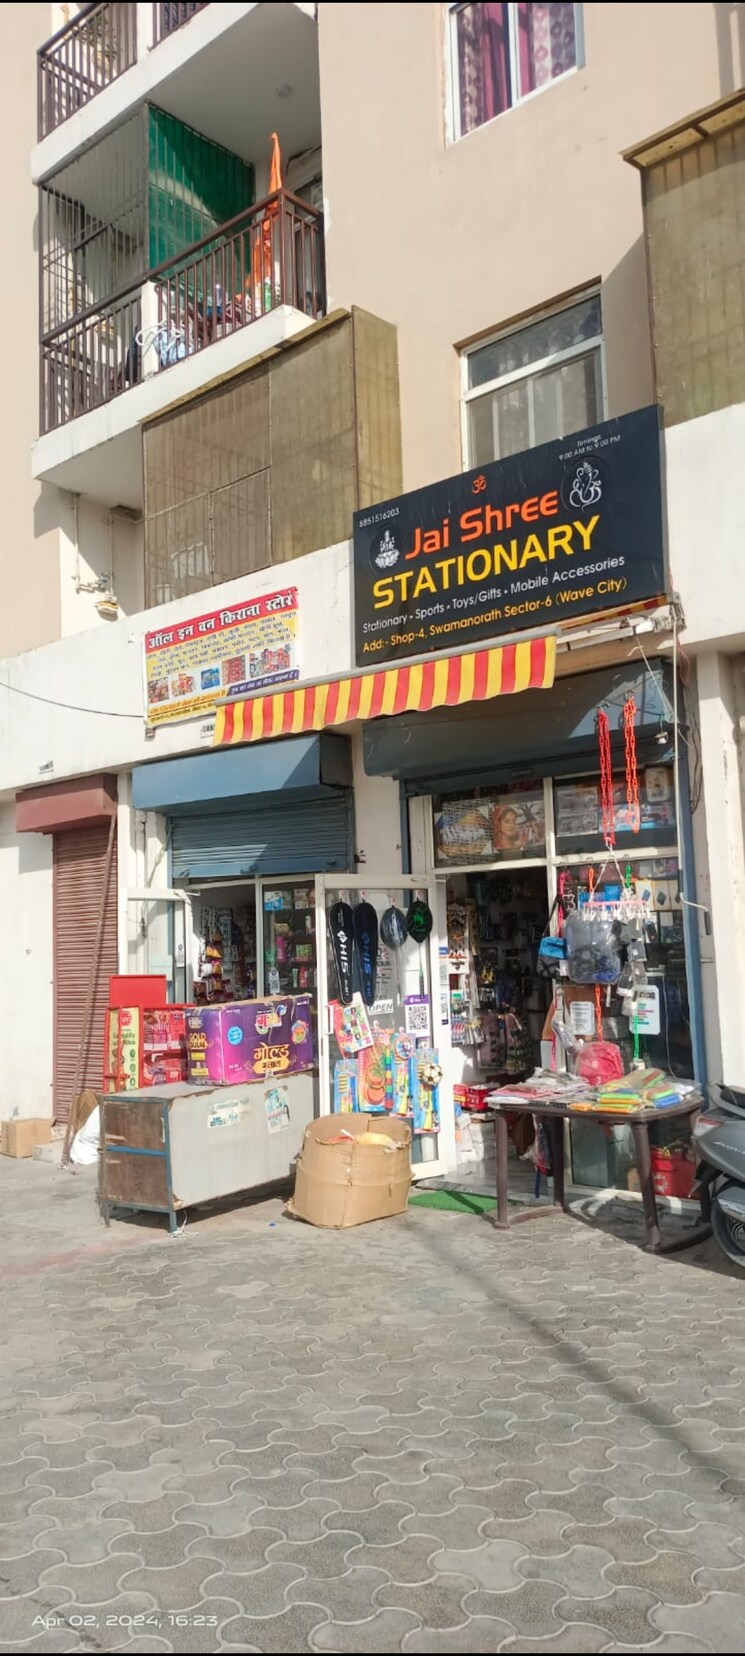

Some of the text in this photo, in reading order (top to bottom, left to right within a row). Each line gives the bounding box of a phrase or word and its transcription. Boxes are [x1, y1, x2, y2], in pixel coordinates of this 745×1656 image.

[573, 447, 585, 457] AM
[609, 434, 621, 444] PM
[577, 435, 601, 447] Timings
[405, 490, 559, 560] Jai Shree
[372, 514, 600, 610] STATIONARY
[148, 592, 293, 649] ऑल इन वन किराना स्टोर
[362, 556, 625, 634] Stationary Sports Toys/Gifts Mobile Accessories
[390, 628, 427, 646] Shop-4,
[429, 608, 502, 636] Swamanorath
[504, 595, 553, 617] Sector-6
[555, 587, 594, 606] (Wave
[597, 576, 628, 594] City)
[369, 1003, 393, 1012] OPEN
[253, 1042, 289, 1060] गोल्ड
